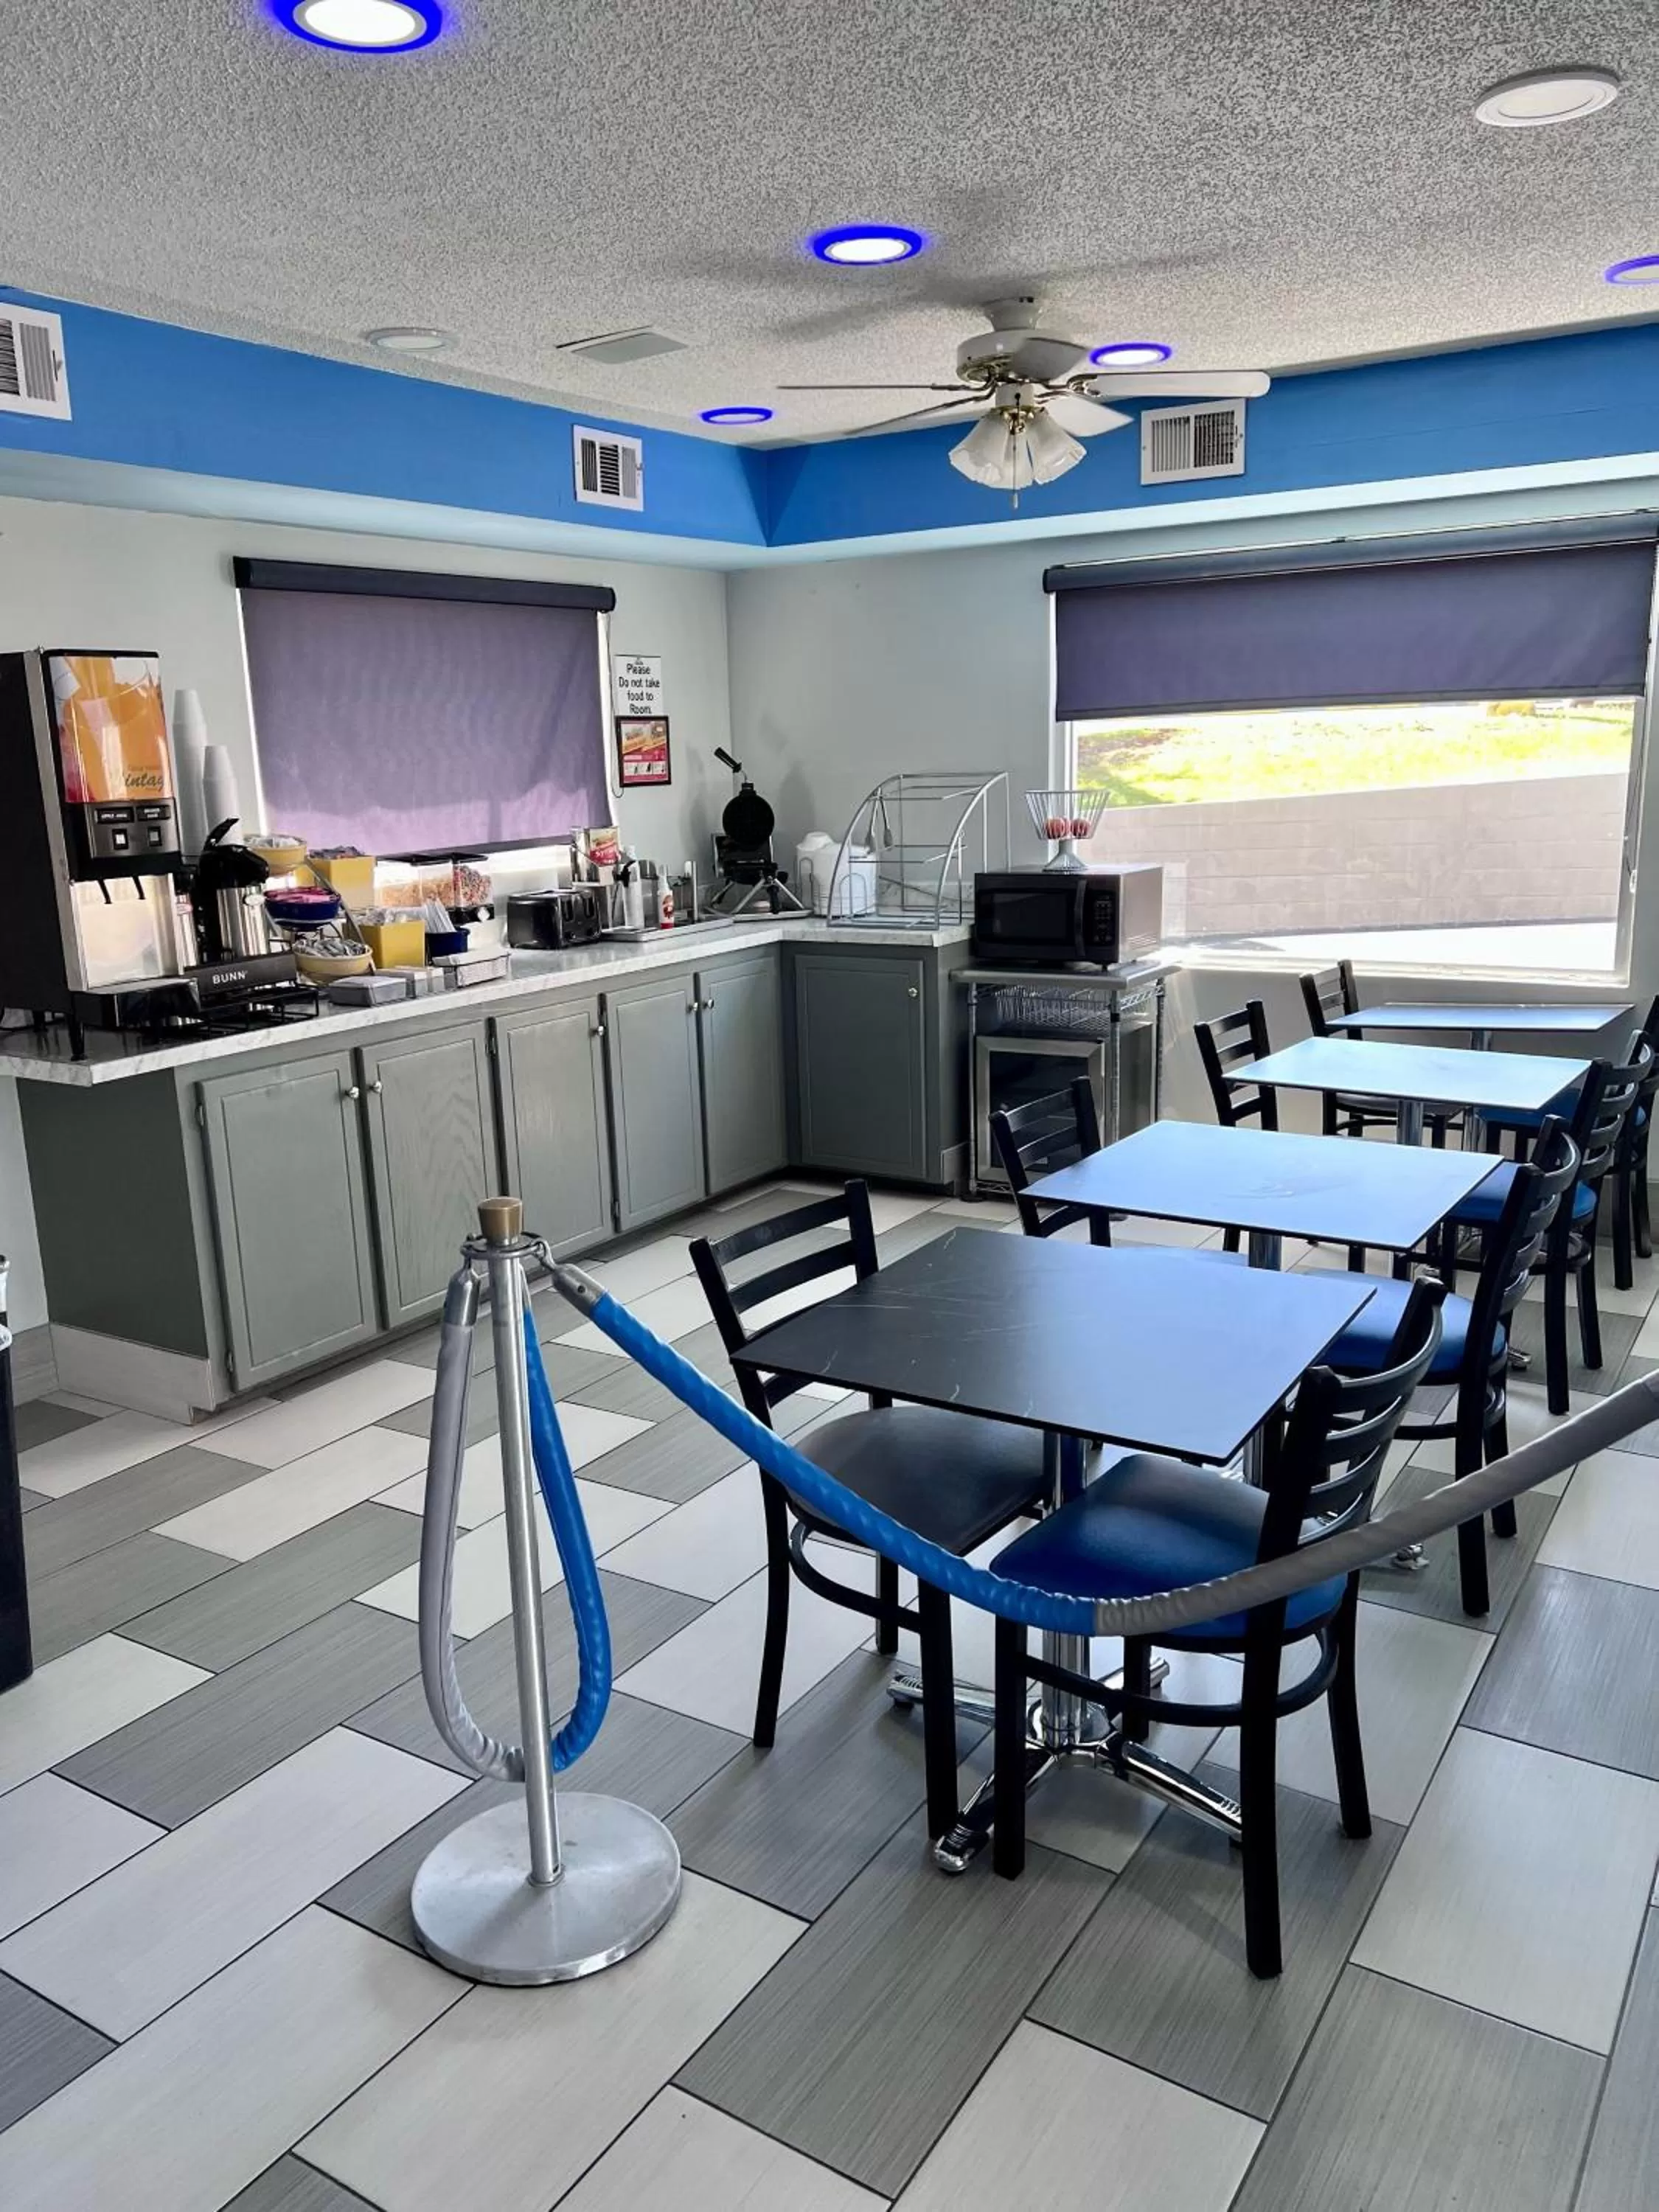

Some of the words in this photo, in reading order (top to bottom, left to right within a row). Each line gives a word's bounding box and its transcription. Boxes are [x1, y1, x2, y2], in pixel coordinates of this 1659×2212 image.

[627, 663, 650, 675] Please
[619, 676, 629, 688] Do
[630, 678, 644, 688] not
[645, 678, 661, 688] take
[627, 689, 644, 701] food
[645, 691, 654, 701] to
[212, 970, 246, 984] BUNN
